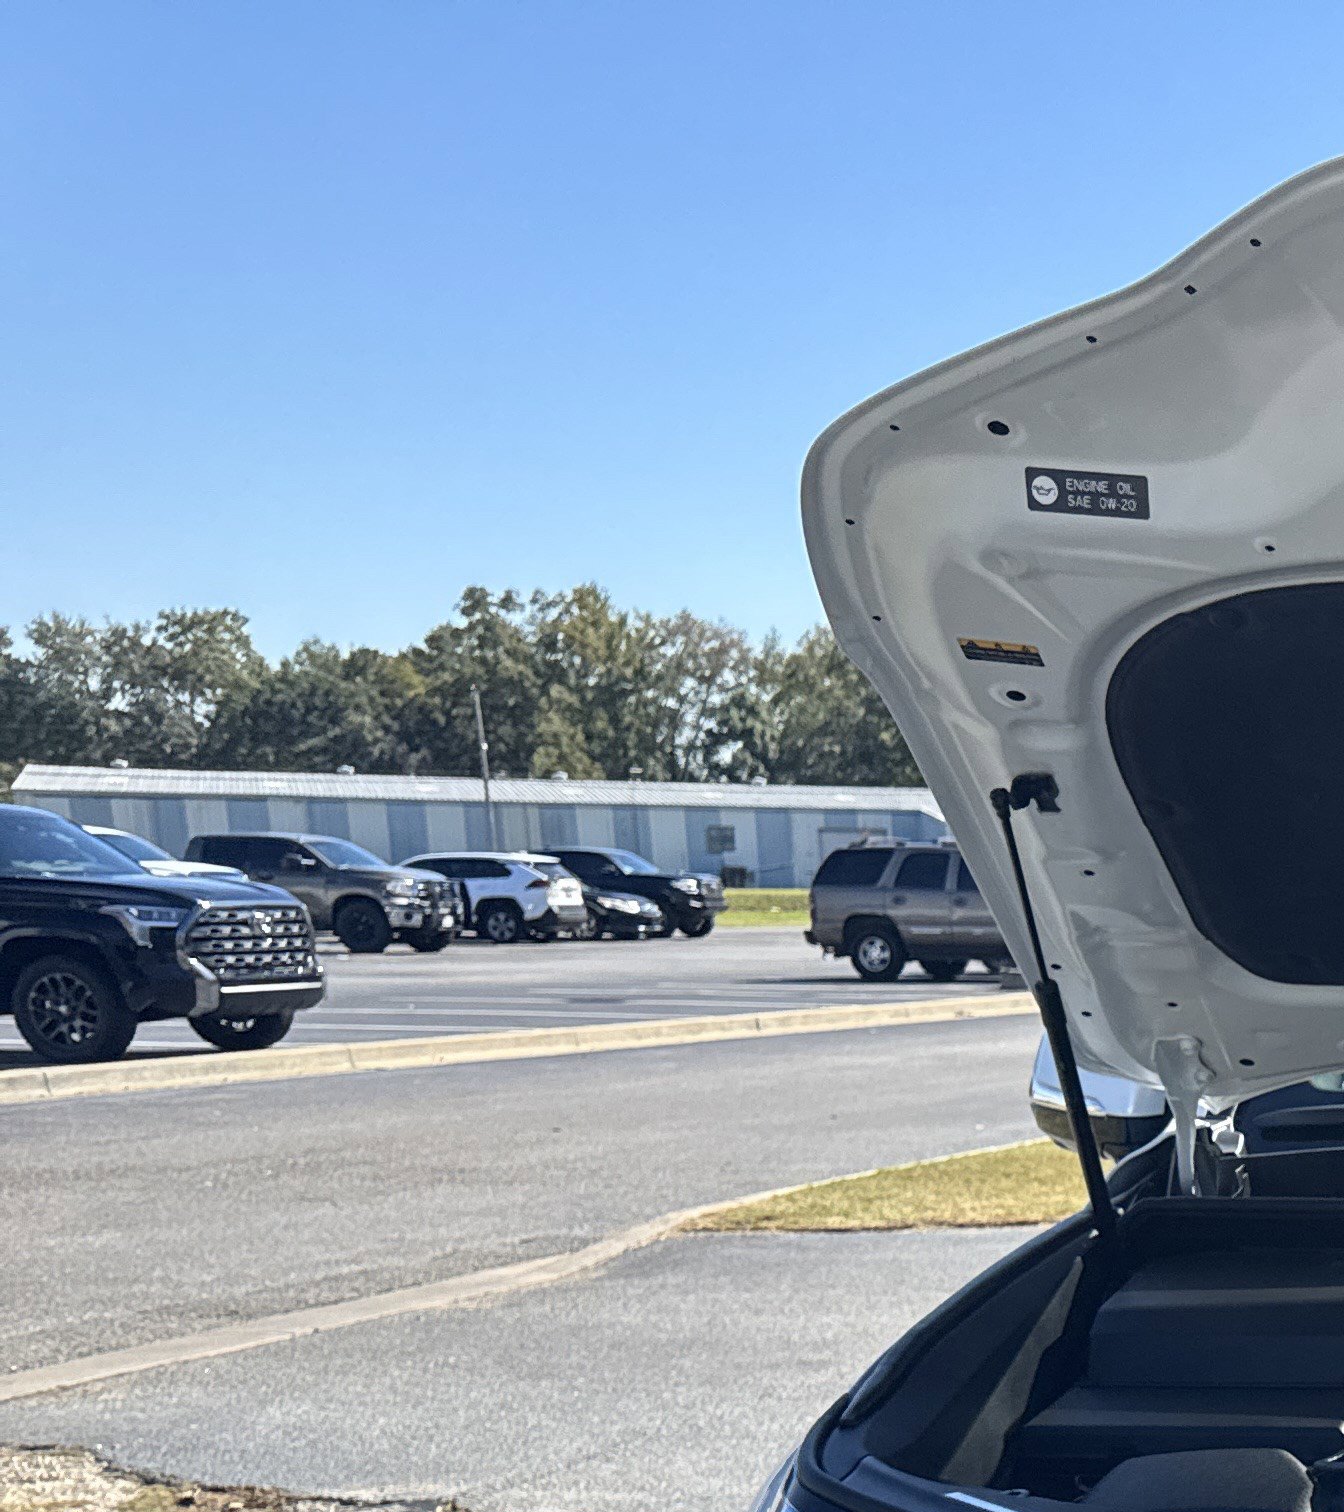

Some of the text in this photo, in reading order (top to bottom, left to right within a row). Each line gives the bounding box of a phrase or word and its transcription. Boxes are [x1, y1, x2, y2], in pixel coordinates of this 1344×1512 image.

[1066, 478, 1136, 496] ENGINE OIL
[1067, 495, 1137, 512] SAE 0W-20
